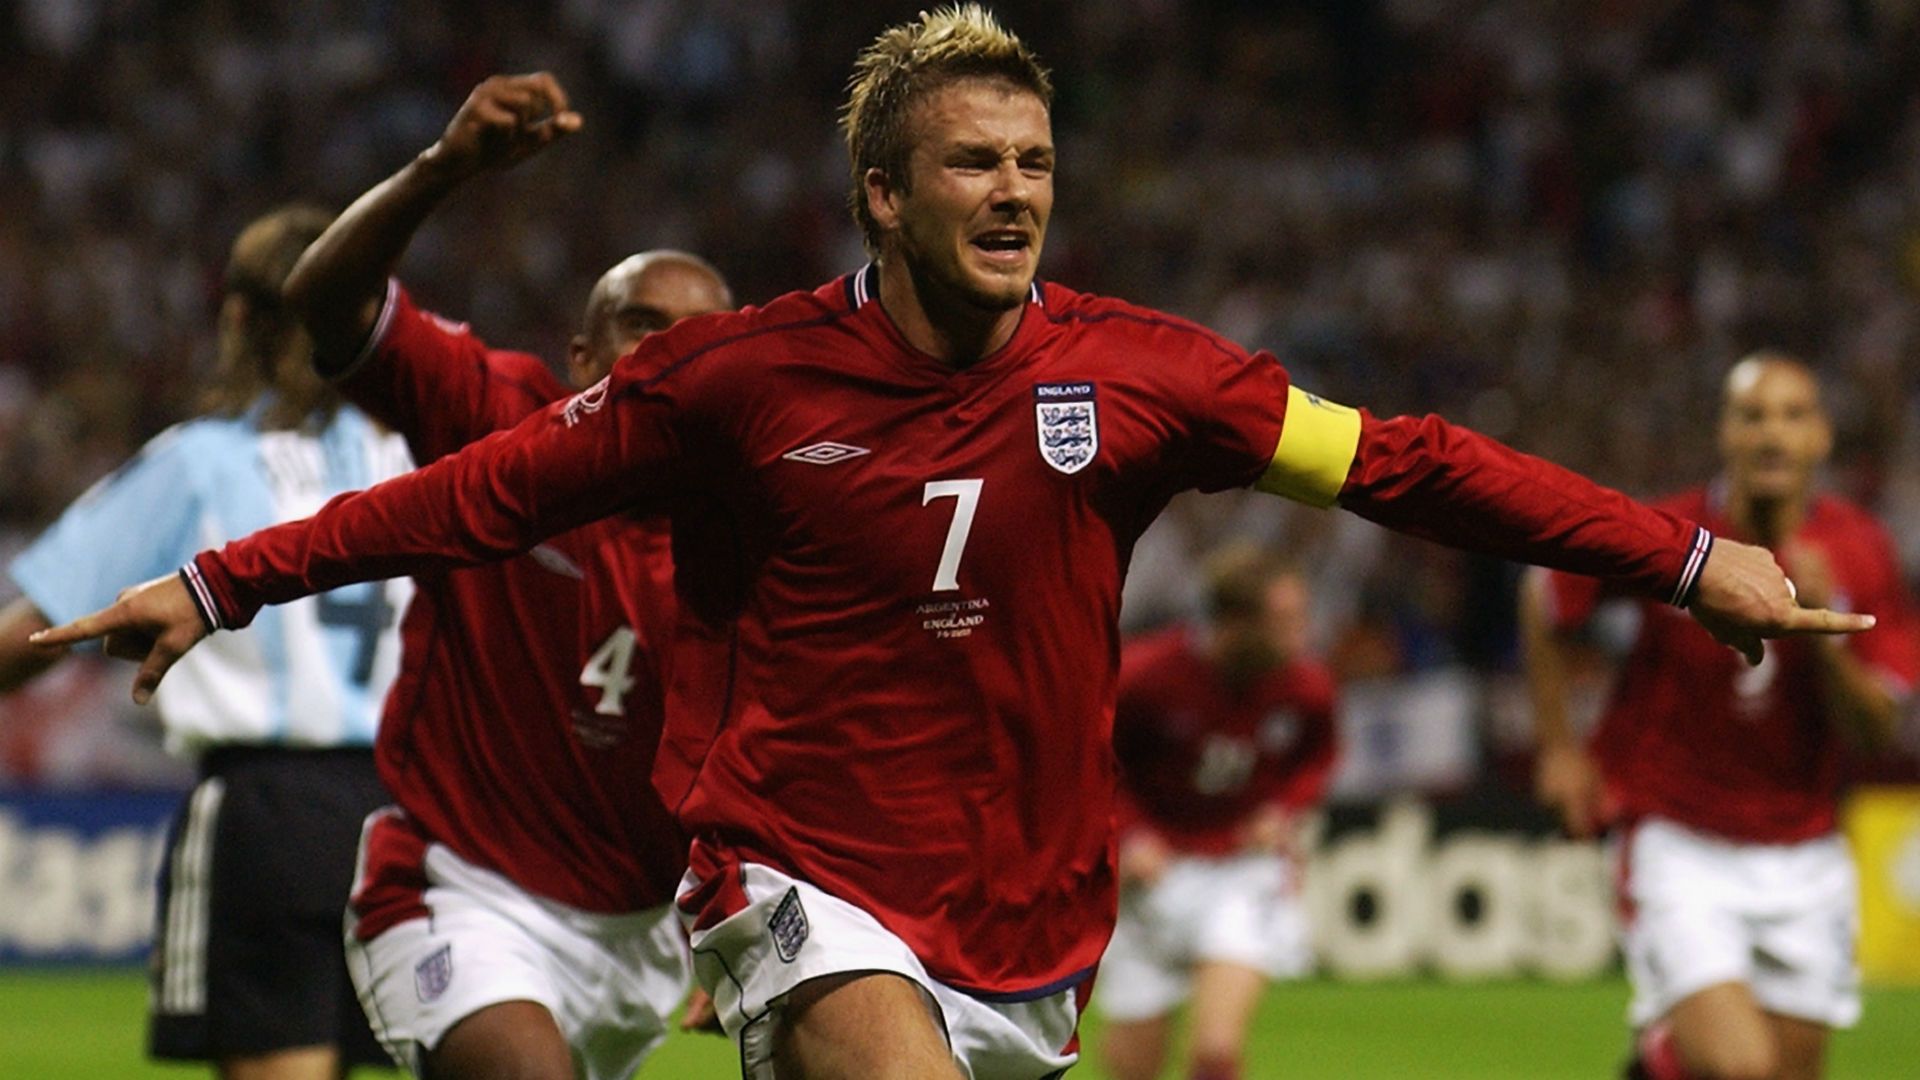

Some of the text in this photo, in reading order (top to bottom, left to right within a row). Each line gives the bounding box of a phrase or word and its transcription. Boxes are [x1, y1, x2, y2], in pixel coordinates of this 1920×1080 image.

[1037, 385, 1091, 396] ENGLAND
[922, 478, 984, 591] 7
[915, 598, 990, 614] ARGENTINA
[923, 614, 984, 629] ENGLAND
[579, 625, 637, 716] 4
